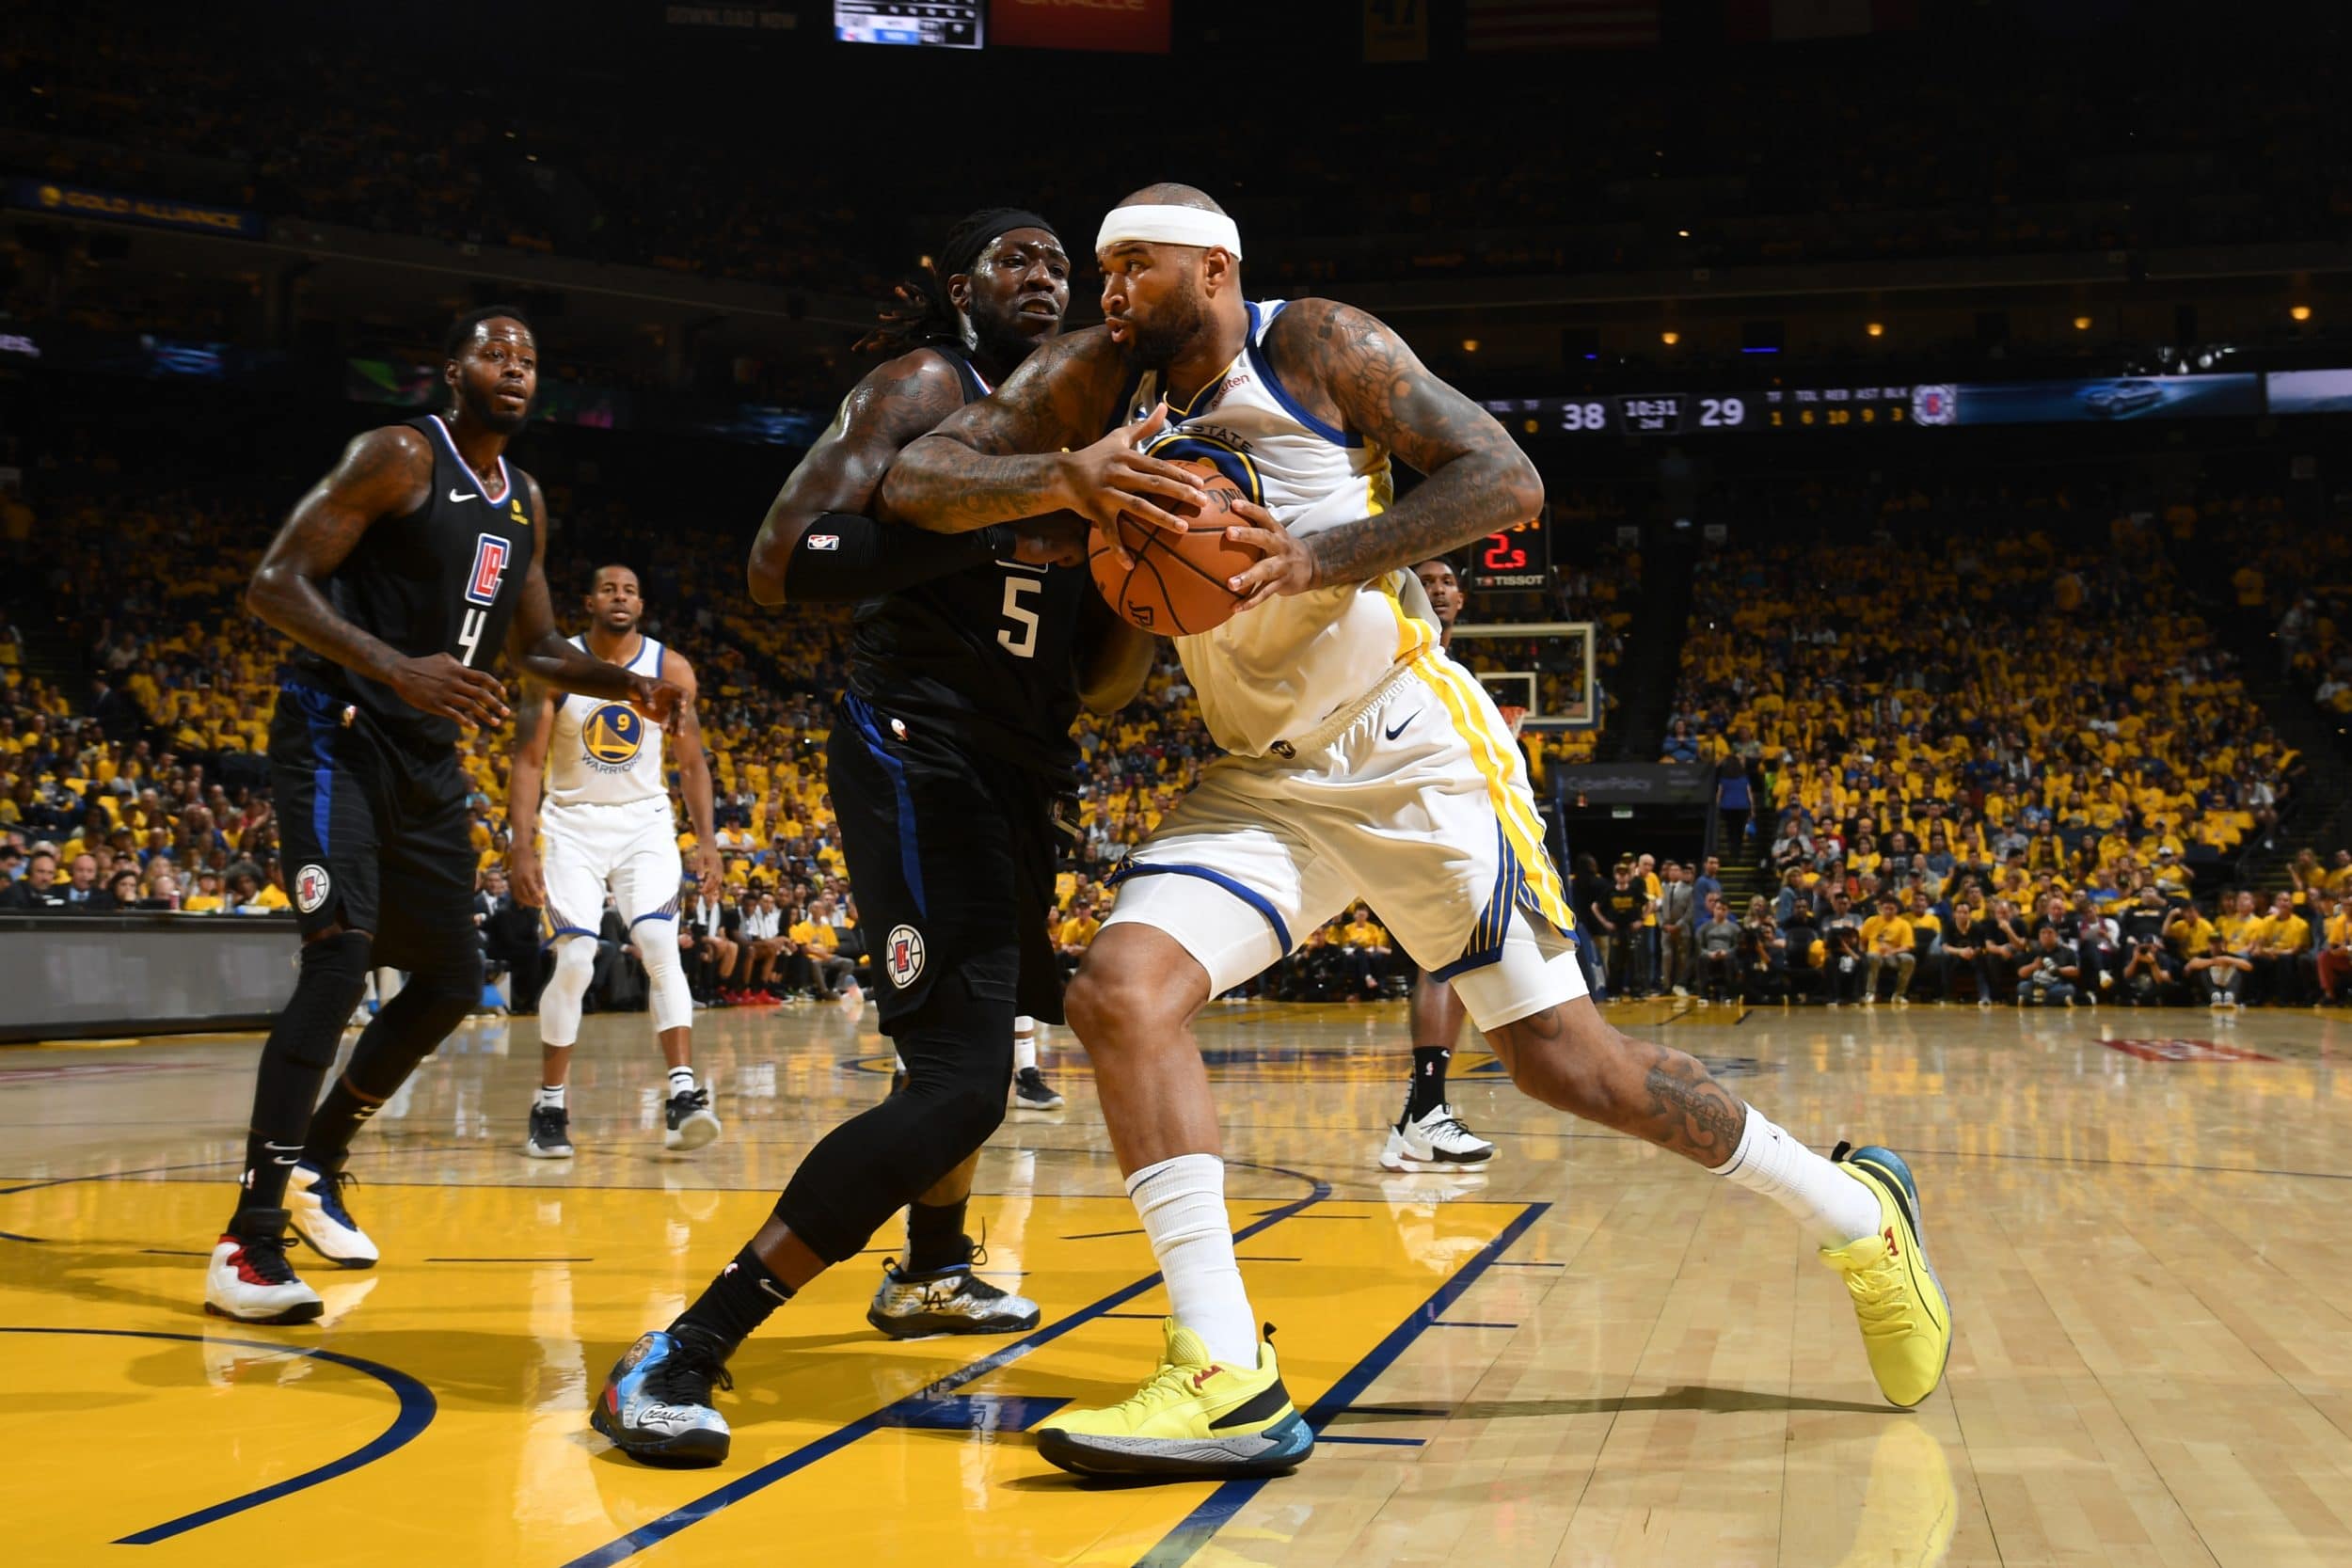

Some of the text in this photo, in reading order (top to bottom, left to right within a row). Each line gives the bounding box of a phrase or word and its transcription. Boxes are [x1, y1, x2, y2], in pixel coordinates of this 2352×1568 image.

[1855, 388, 1880, 400] AST
[1883, 387, 1909, 399] BLK
[1562, 403, 1605, 431] 38
[1626, 400, 1678, 417] 10:31
[1700, 398, 1744, 426] 29
[1771, 410, 1783, 426] 1
[1801, 409, 1815, 425] 6
[1828, 409, 1850, 424] 10
[1192, 424, 1254, 452] STATE
[1494, 575, 1545, 586] TISSOT
[997, 576, 1042, 658] 5
[458, 609, 487, 667] 4
[616, 713, 631, 732] 9
[581, 752, 644, 775] WARRIORS
[923, 1281, 950, 1312] LA
